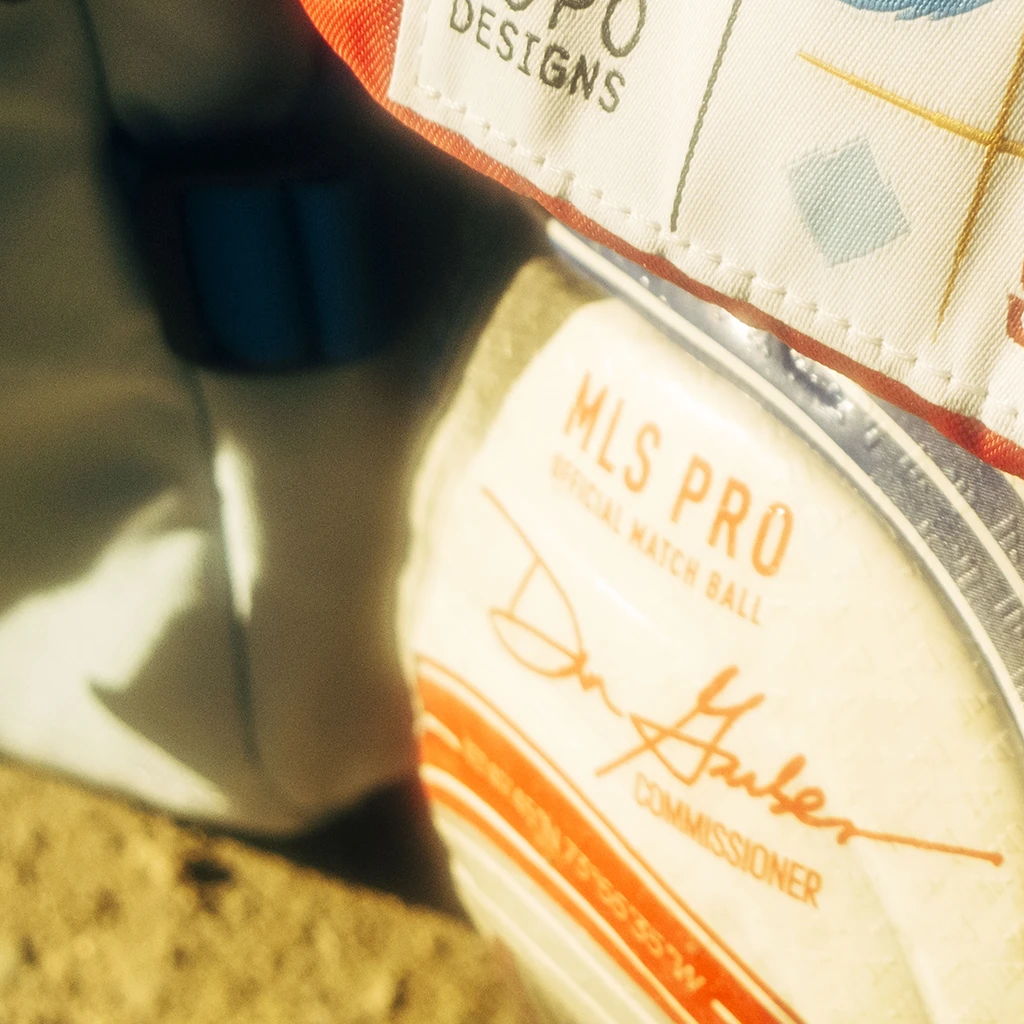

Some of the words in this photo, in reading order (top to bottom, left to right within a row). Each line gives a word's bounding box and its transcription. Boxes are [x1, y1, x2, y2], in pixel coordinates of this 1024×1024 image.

[562, 369, 662, 494] MLS
[669, 451, 795, 578] PRO
[629, 519, 701, 587] MATCH
[705, 569, 764, 626] BALL
[633, 771, 824, 910] COMMISSIONER
